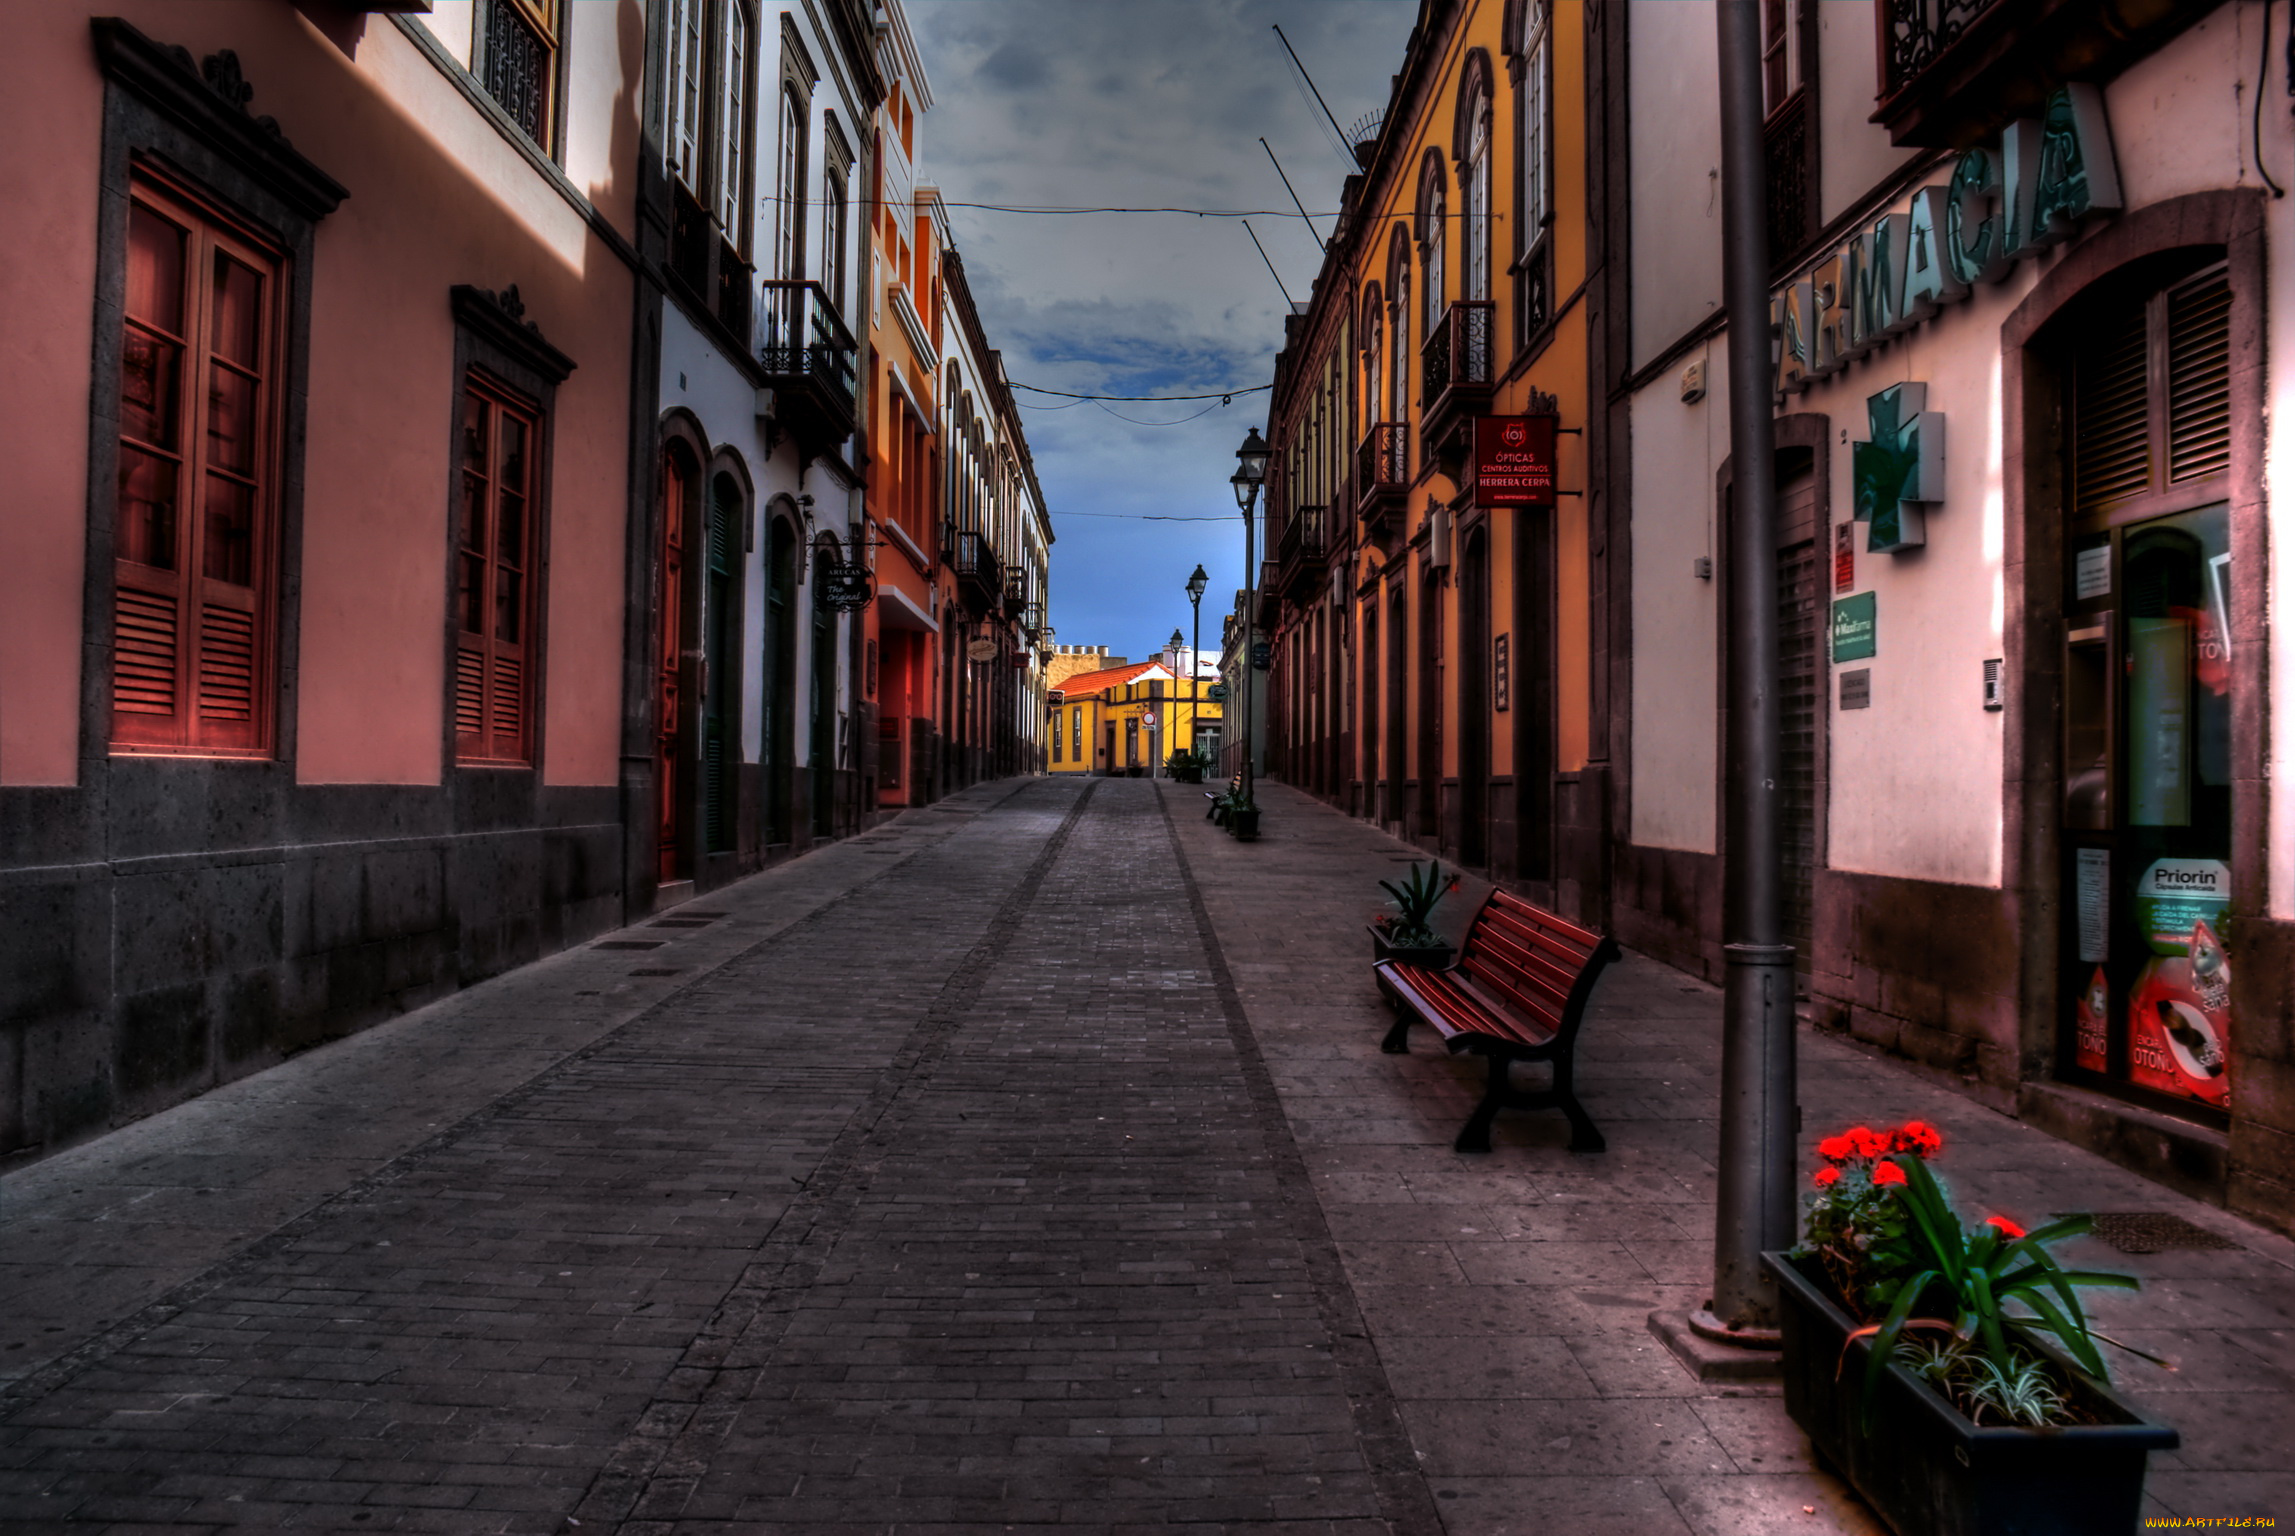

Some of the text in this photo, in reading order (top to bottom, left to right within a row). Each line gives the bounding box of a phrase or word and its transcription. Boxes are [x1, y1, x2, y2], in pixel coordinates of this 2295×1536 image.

[1770, 82, 2118, 395] ARMACIA
[1495, 451, 1535, 463] ÓPTICAS
[1481, 465, 1548, 473] CENTROS AUDITIVOS
[1479, 478, 1551, 487] HERRERA CERPA
[827, 585, 844, 593] The
[826, 592, 862, 605] Original
[2154, 868, 2217, 885] Priorin
